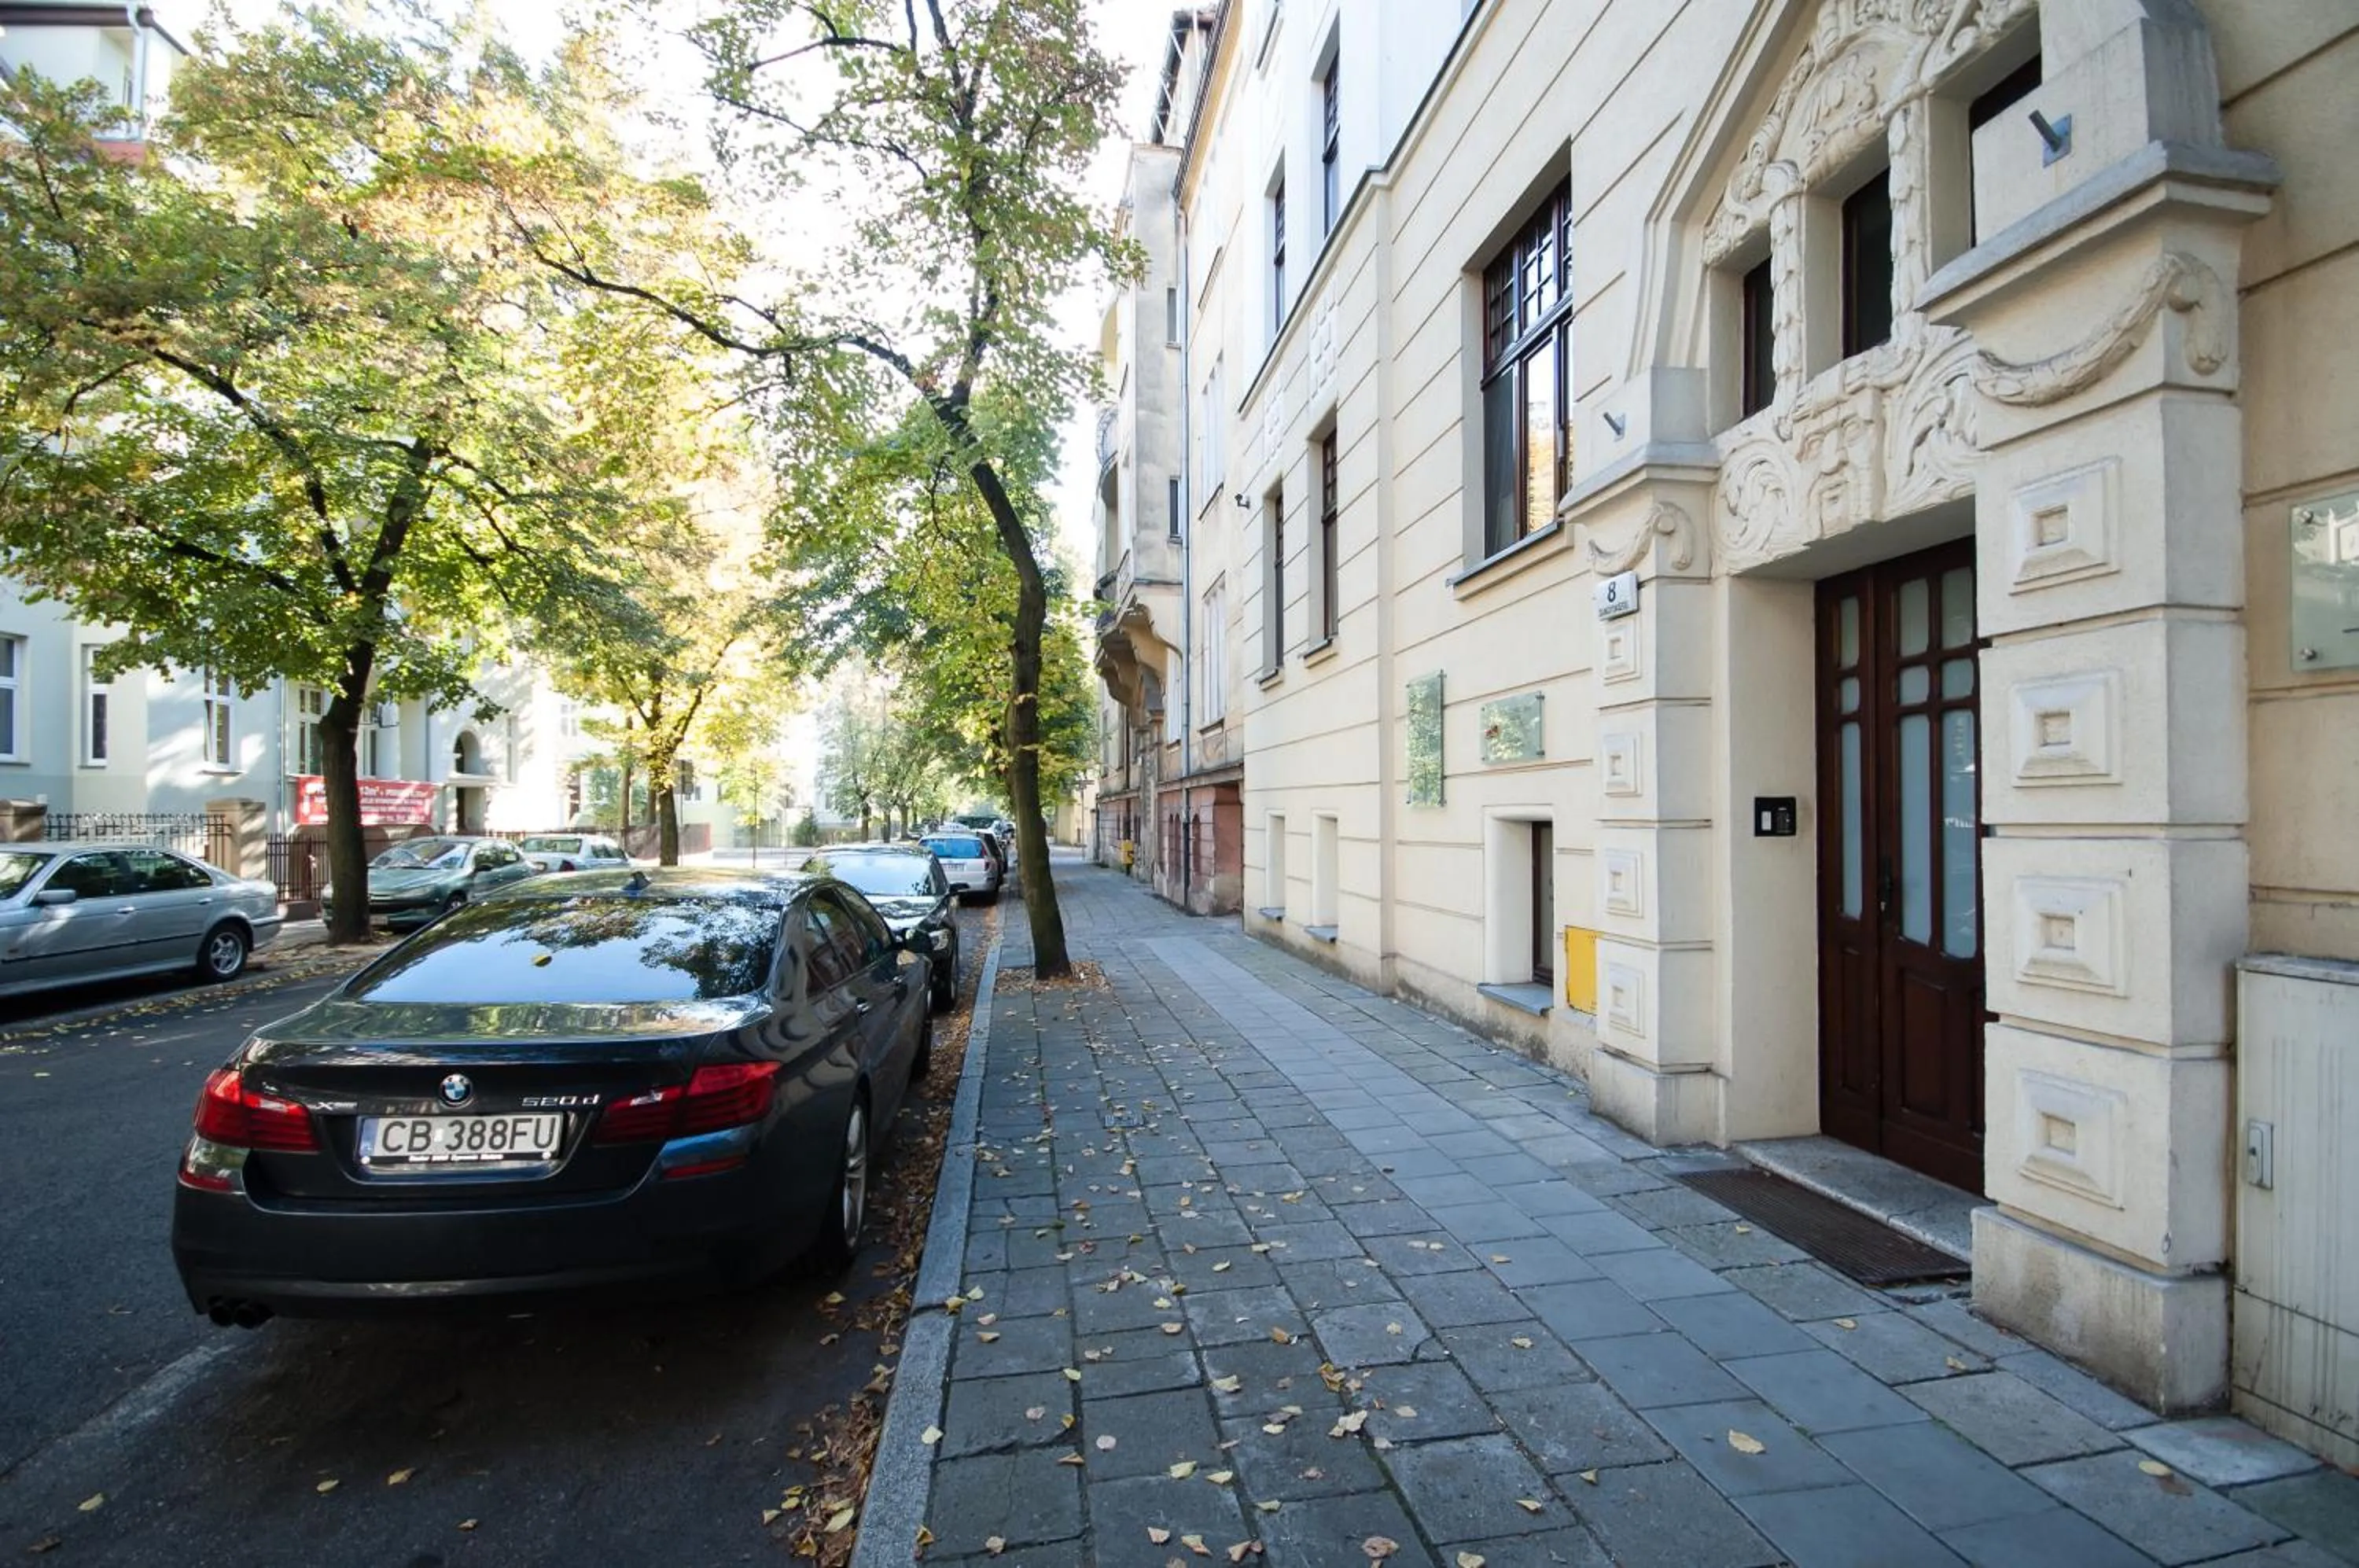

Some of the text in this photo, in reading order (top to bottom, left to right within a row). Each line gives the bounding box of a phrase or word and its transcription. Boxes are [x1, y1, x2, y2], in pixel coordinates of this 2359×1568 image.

[1607, 580, 1616, 602] 8
[382, 1117, 556, 1152] CB 388FU
